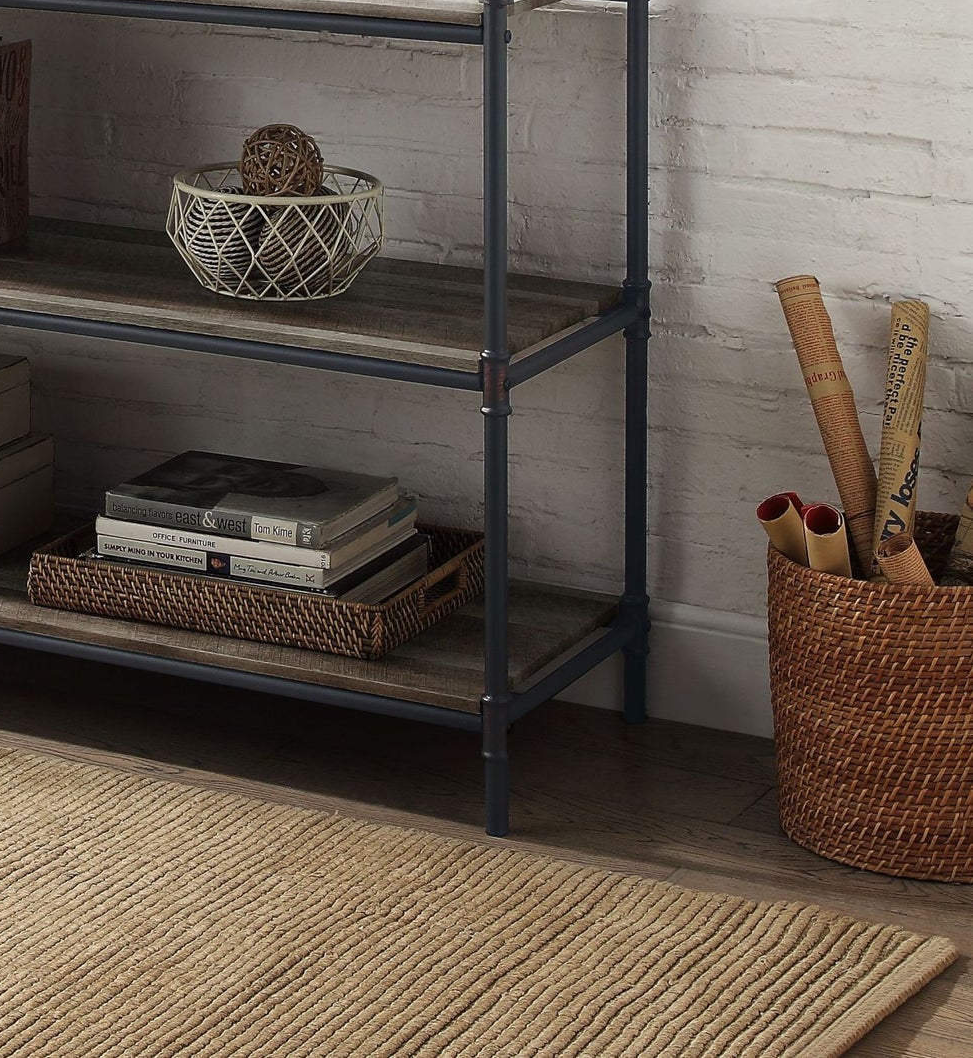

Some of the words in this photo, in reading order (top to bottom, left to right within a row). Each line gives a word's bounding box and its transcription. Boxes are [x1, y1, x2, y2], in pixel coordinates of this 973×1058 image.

[896, 334, 909, 349] be
[903, 336, 919, 356] the
[887, 353, 901, 385] nicer
[890, 357, 910, 403] perfect
[112, 502, 147, 518] balancing
[148, 507, 173, 520] flavors
[253, 522, 271, 534] Tom
[272, 524, 293, 538] Kime
[152, 532, 176, 542] OFFICE
[179, 536, 217, 549] FURNITURE
[104, 543, 127, 552] SIMPLY
[128, 547, 146, 556] MING
[156, 551, 175, 561] YOUR
[175, 554, 203, 564] KITCHEN
[233, 563, 246, 573] Ming
